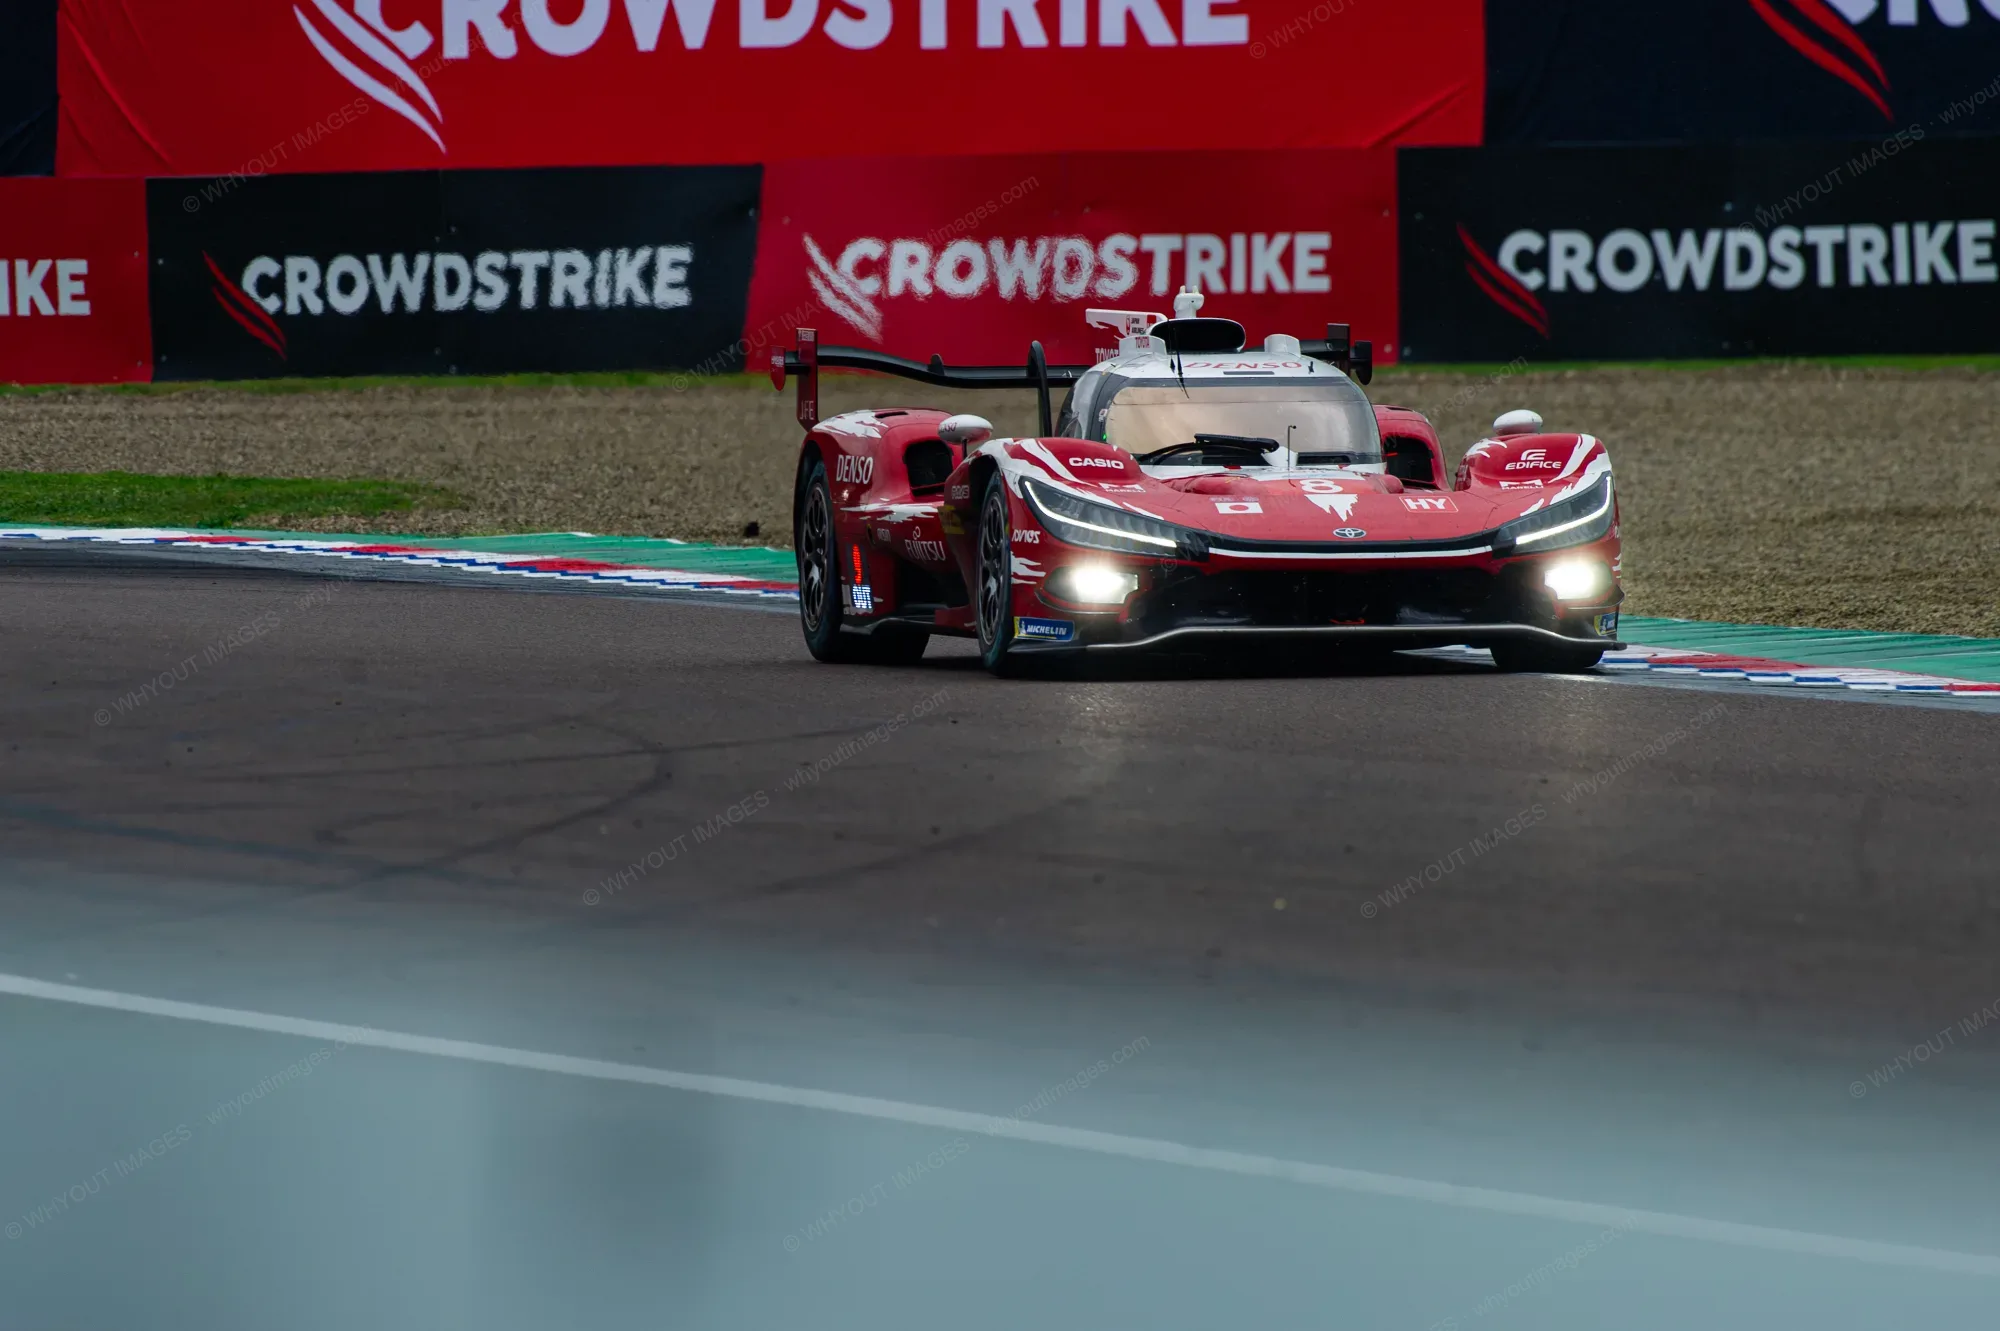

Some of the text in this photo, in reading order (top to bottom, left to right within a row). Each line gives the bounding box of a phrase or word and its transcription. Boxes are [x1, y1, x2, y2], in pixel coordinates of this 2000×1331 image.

[1498, 219, 1997, 292] CROWDSTRIKE
[838, 232, 1331, 301] CROWDSTRIKE
[242, 243, 693, 315] CROWDSTRIKE
[1095, 347, 1120, 364] TOYOT
[1184, 361, 1302, 369] DENSO
[800, 400, 815, 420] JFE
[836, 454, 874, 485] DENSO
[1069, 457, 1125, 469] CASIO
[1505, 461, 1562, 471] EDIFICE
[1300, 479, 1344, 494] 8
[1404, 497, 1447, 510] HY
[904, 539, 946, 561] FUJITSU
[1026, 624, 1067, 636] MICHELIN
